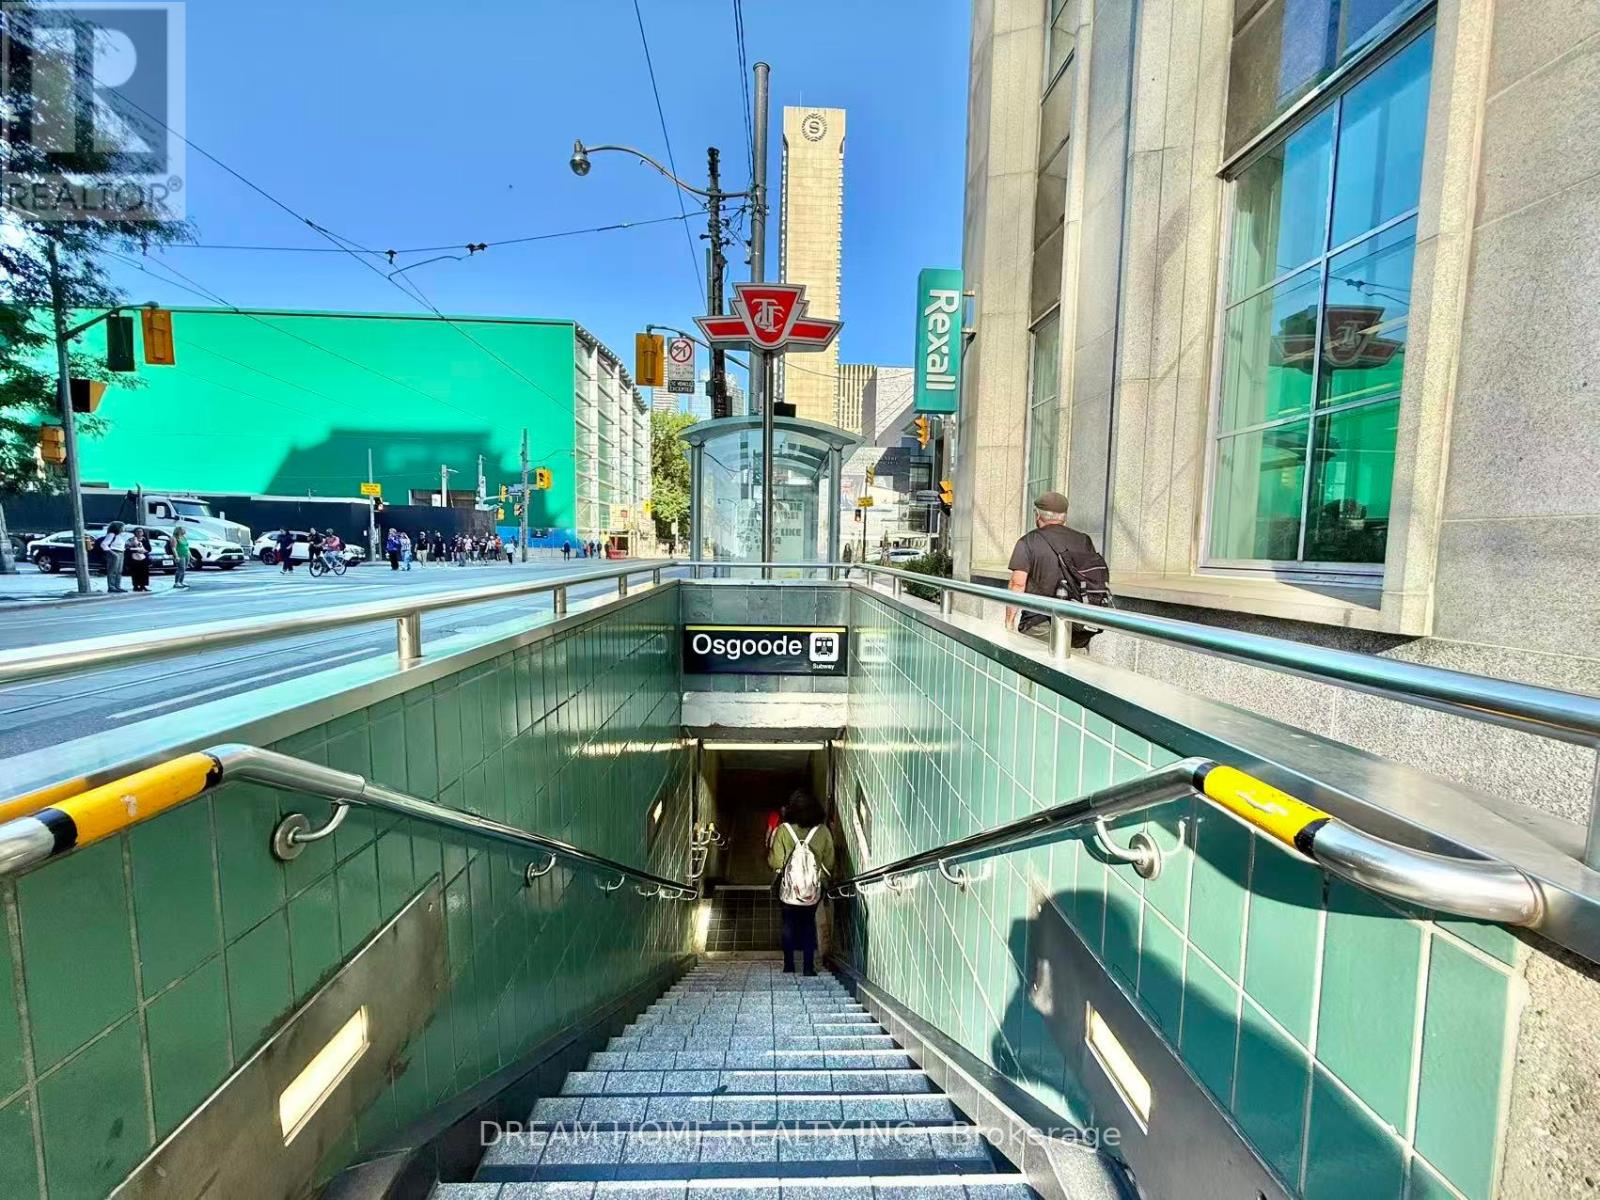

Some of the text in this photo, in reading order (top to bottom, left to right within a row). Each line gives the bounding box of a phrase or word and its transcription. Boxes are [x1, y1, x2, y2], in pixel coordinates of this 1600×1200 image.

[808, 120, 821, 135] S
[924, 288, 960, 391] Rexall
[692, 633, 803, 660] Osgoode
[812, 662, 836, 671] Subway
